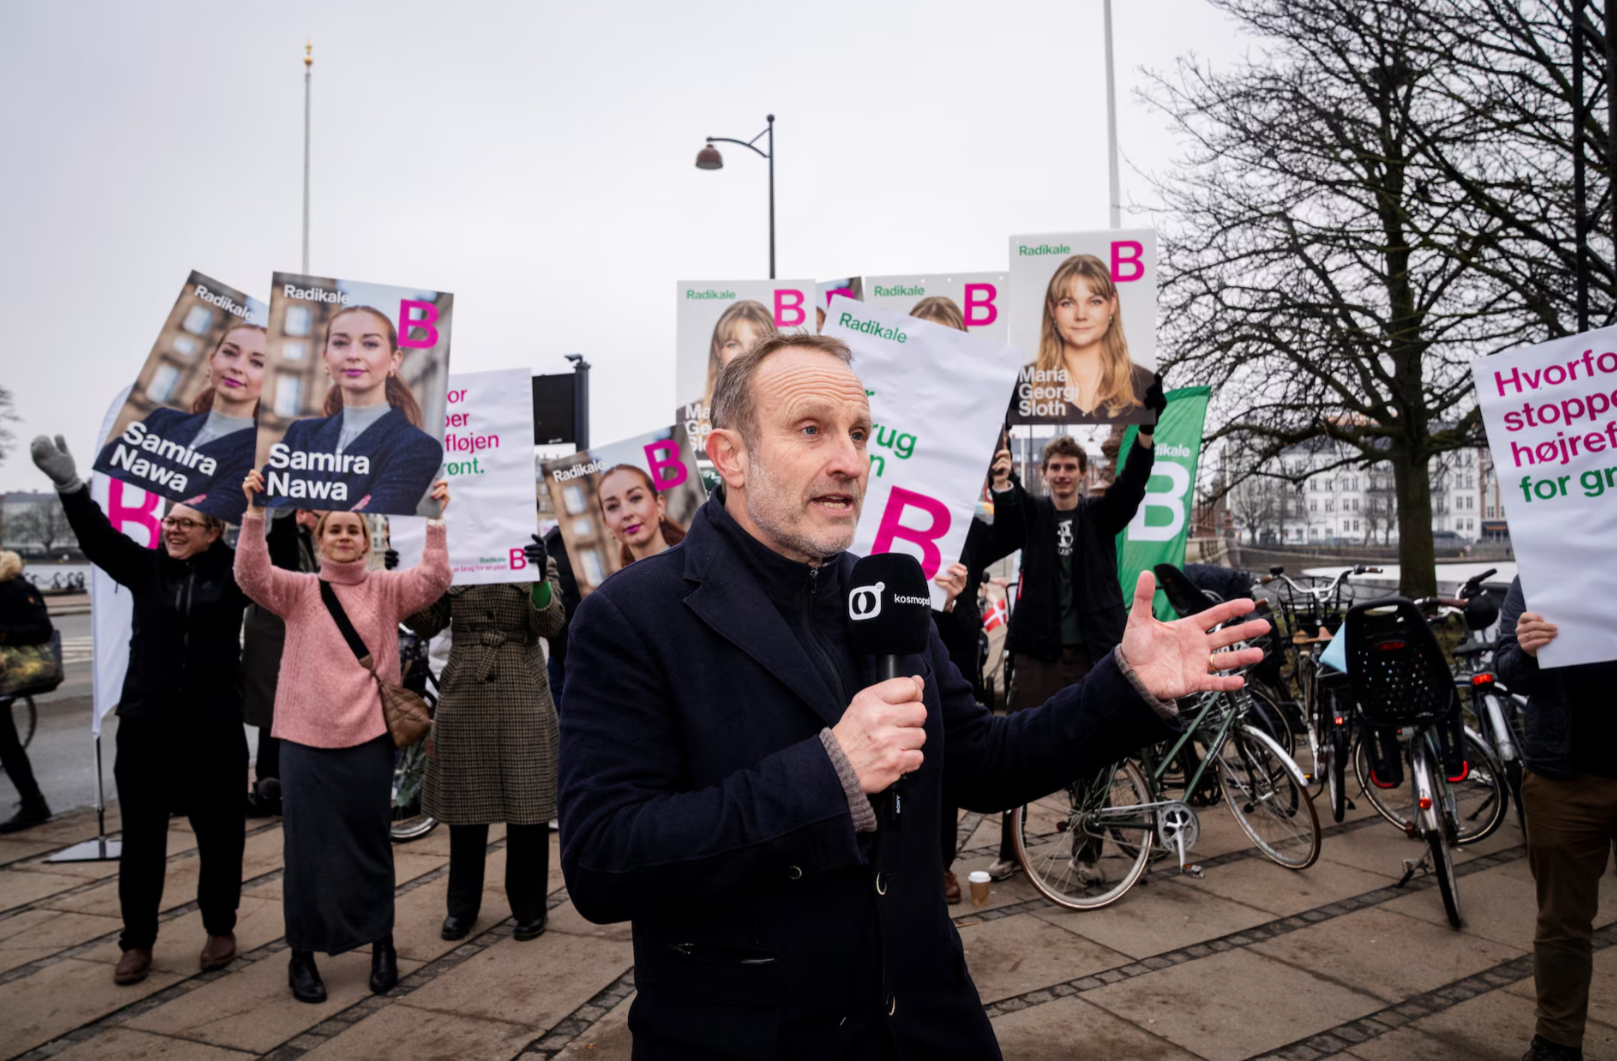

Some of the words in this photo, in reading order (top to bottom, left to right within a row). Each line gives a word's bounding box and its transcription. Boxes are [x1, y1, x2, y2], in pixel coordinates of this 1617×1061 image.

[1019, 244, 1071, 256] Radikale
[1110, 240, 1145, 283] B
[193, 284, 255, 322] Radikale
[283, 284, 350, 305] Radikale
[686, 289, 736, 300] Radikale
[874, 285, 925, 297] Radikale
[963, 282, 998, 327] B
[396, 298, 440, 349] B
[773, 289, 806, 328] B
[839, 312, 908, 344] Radikale
[1019, 366, 1068, 383] Maria
[1018, 383, 1080, 402] Georgi
[1018, 400, 1066, 417] Sloth
[122, 420, 218, 476] Samira
[268, 443, 370, 475] Samira
[109, 443, 189, 493] Nawa
[552, 459, 607, 483] Radikale
[643, 438, 688, 492] B
[266, 472, 348, 501] Nawa
[1128, 461, 1190, 541] B
[1519, 475, 1571, 503] for
[868, 485, 952, 581] B
[509, 548, 527, 571] B
